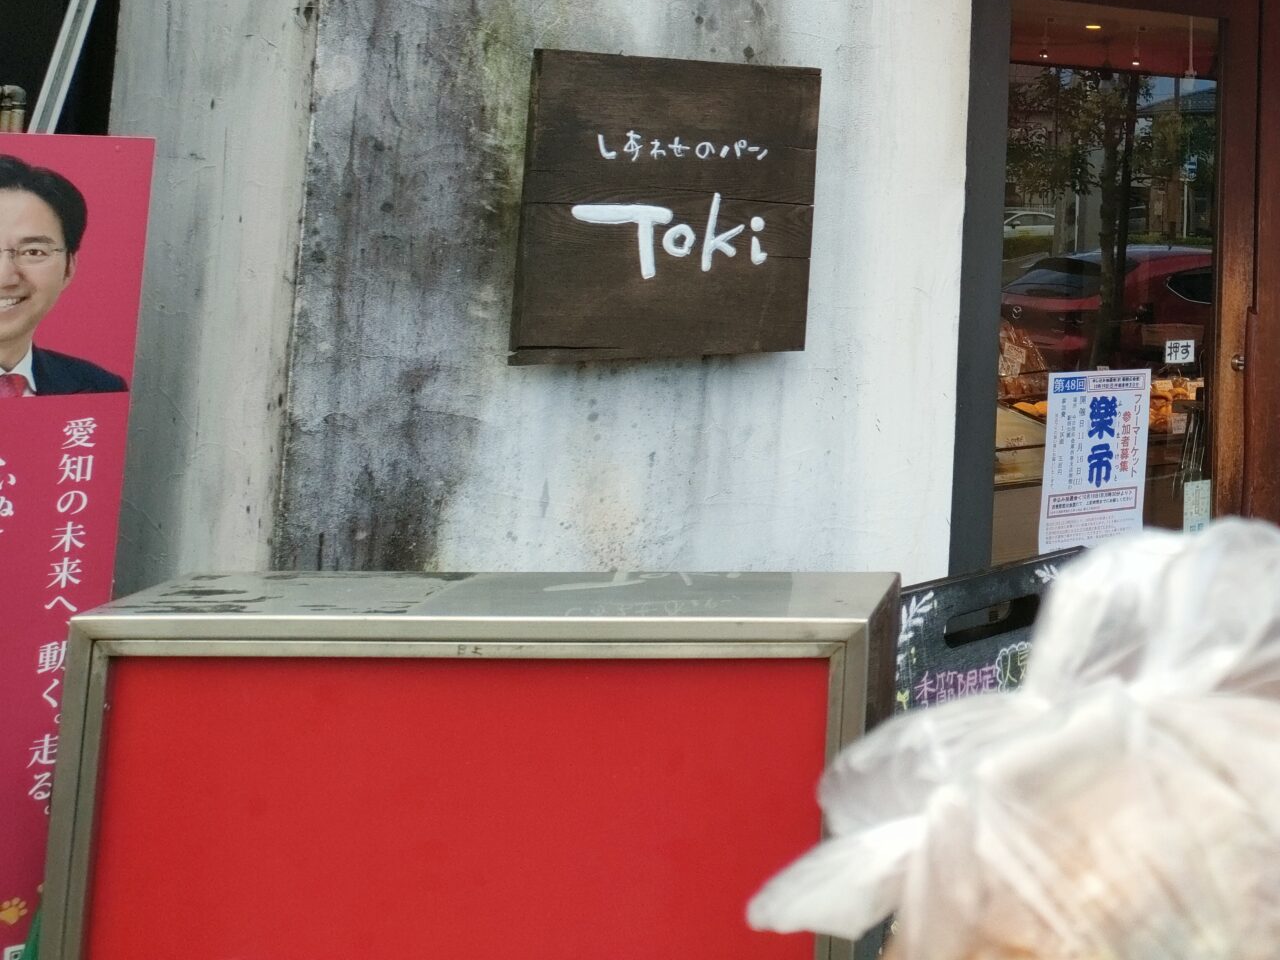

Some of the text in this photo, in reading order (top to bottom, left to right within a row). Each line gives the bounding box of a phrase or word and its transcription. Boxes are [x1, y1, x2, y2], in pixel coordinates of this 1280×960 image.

[598, 130, 768, 161] しあわせのパン
[571, 192, 768, 279] Toki
[1167, 342, 1192, 361] 押す
[1054, 378, 1086, 392] 第48回
[1119, 411, 1132, 472] 参加者募集
[1131, 393, 1142, 478] フリーマーケット
